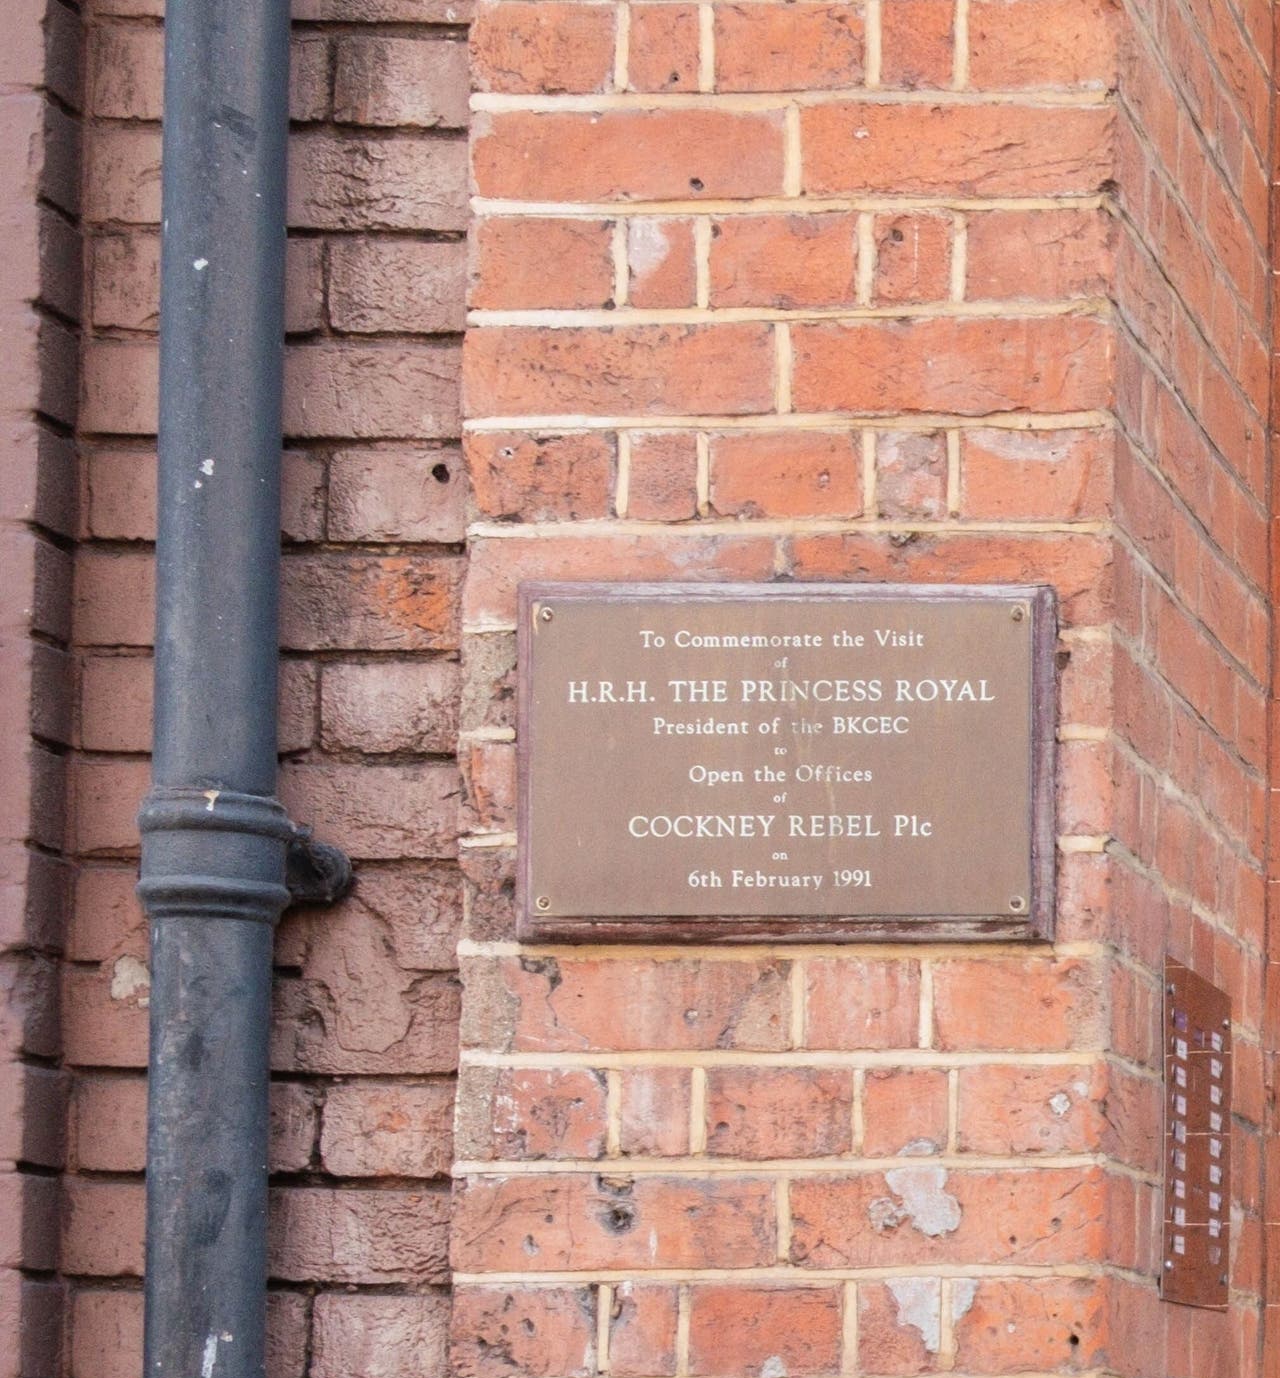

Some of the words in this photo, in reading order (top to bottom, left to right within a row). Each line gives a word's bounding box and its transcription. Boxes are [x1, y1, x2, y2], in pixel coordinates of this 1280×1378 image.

[639, 630, 666, 648] To
[674, 630, 823, 648] Commemorate
[832, 629, 865, 647] the
[874, 629, 924, 647] Visit
[773, 656, 788, 669] of
[567, 680, 656, 703] H.R.H.
[667, 680, 728, 703] THE
[740, 679, 883, 702] PRINCESS
[895, 679, 996, 702] ROYAL
[653, 716, 749, 735] President
[758, 716, 781, 735] of
[791, 717, 823, 735] the
[832, 716, 910, 735] BKCEC
[773, 746, 788, 756] to
[689, 764, 745, 786] Open
[753, 765, 786, 783] the
[795, 764, 873, 783] Offices
[772, 791, 788, 804] of
[628, 815, 776, 838] COCKNEY
[788, 814, 881, 838] REBEL
[893, 814, 933, 837] Plc
[771, 851, 788, 861] on
[687, 869, 723, 888] 6th
[731, 869, 823, 891] February
[832, 869, 872, 888] 1991
